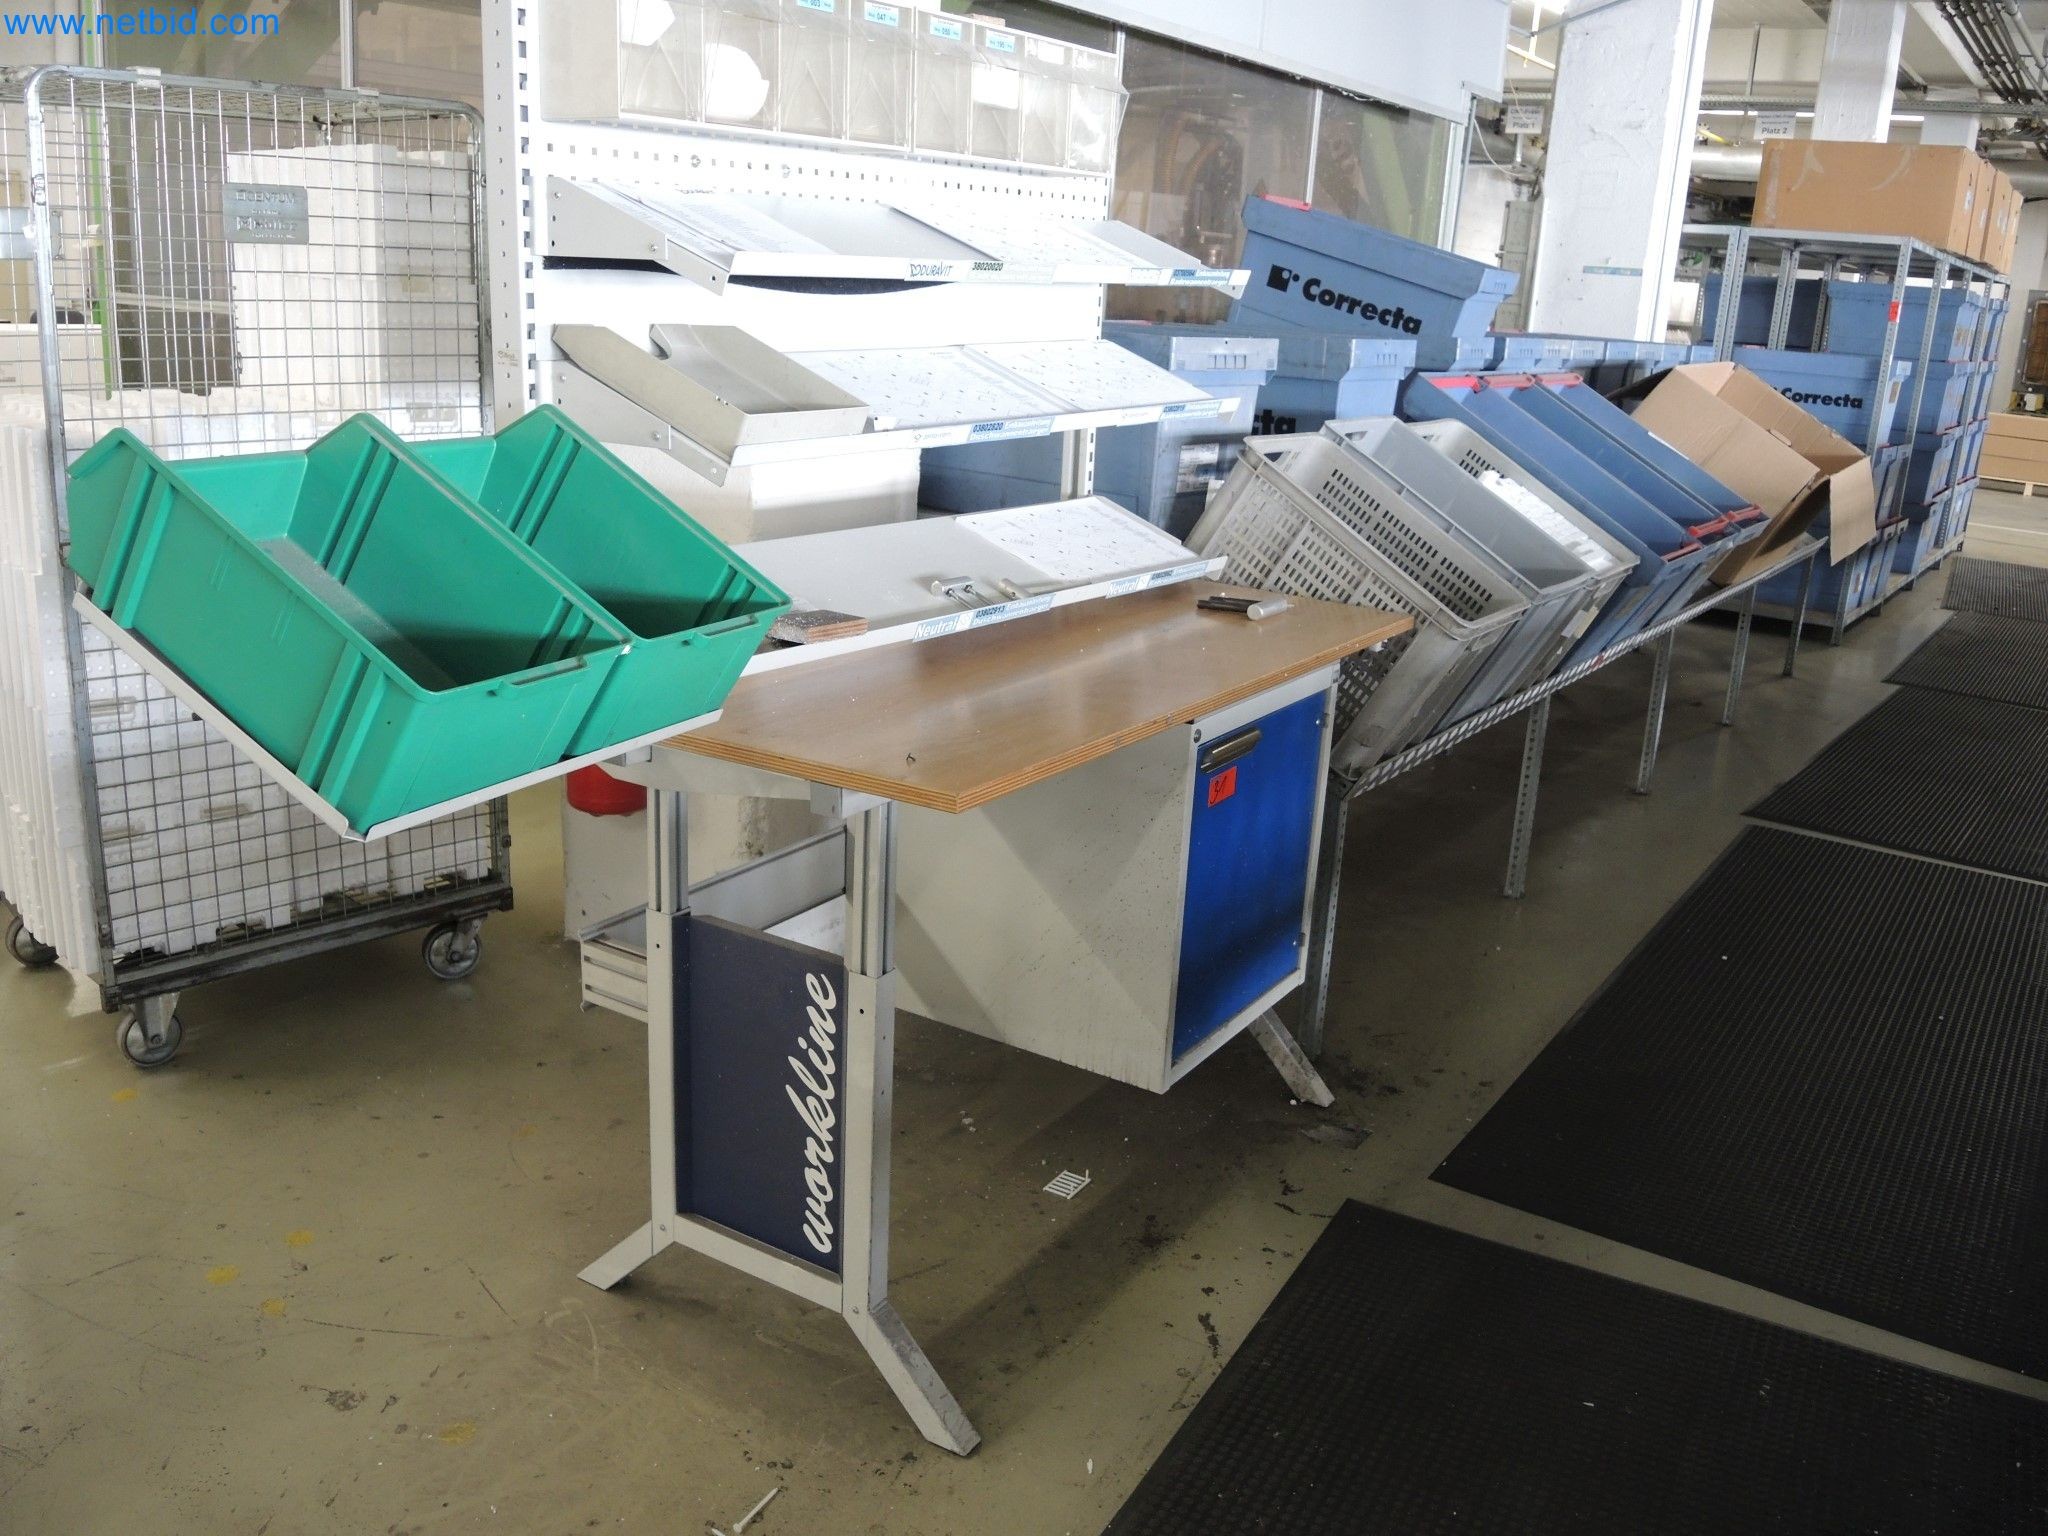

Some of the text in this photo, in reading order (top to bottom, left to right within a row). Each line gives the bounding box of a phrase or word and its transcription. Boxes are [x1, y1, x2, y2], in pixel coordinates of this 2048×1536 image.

[1761, 127, 1781, 135] Platz
[1302, 277, 1423, 336] Correcta
[1780, 387, 1864, 409] Correcta
[914, 617, 958, 639] Neutral
[785, 972, 837, 1254] workline
